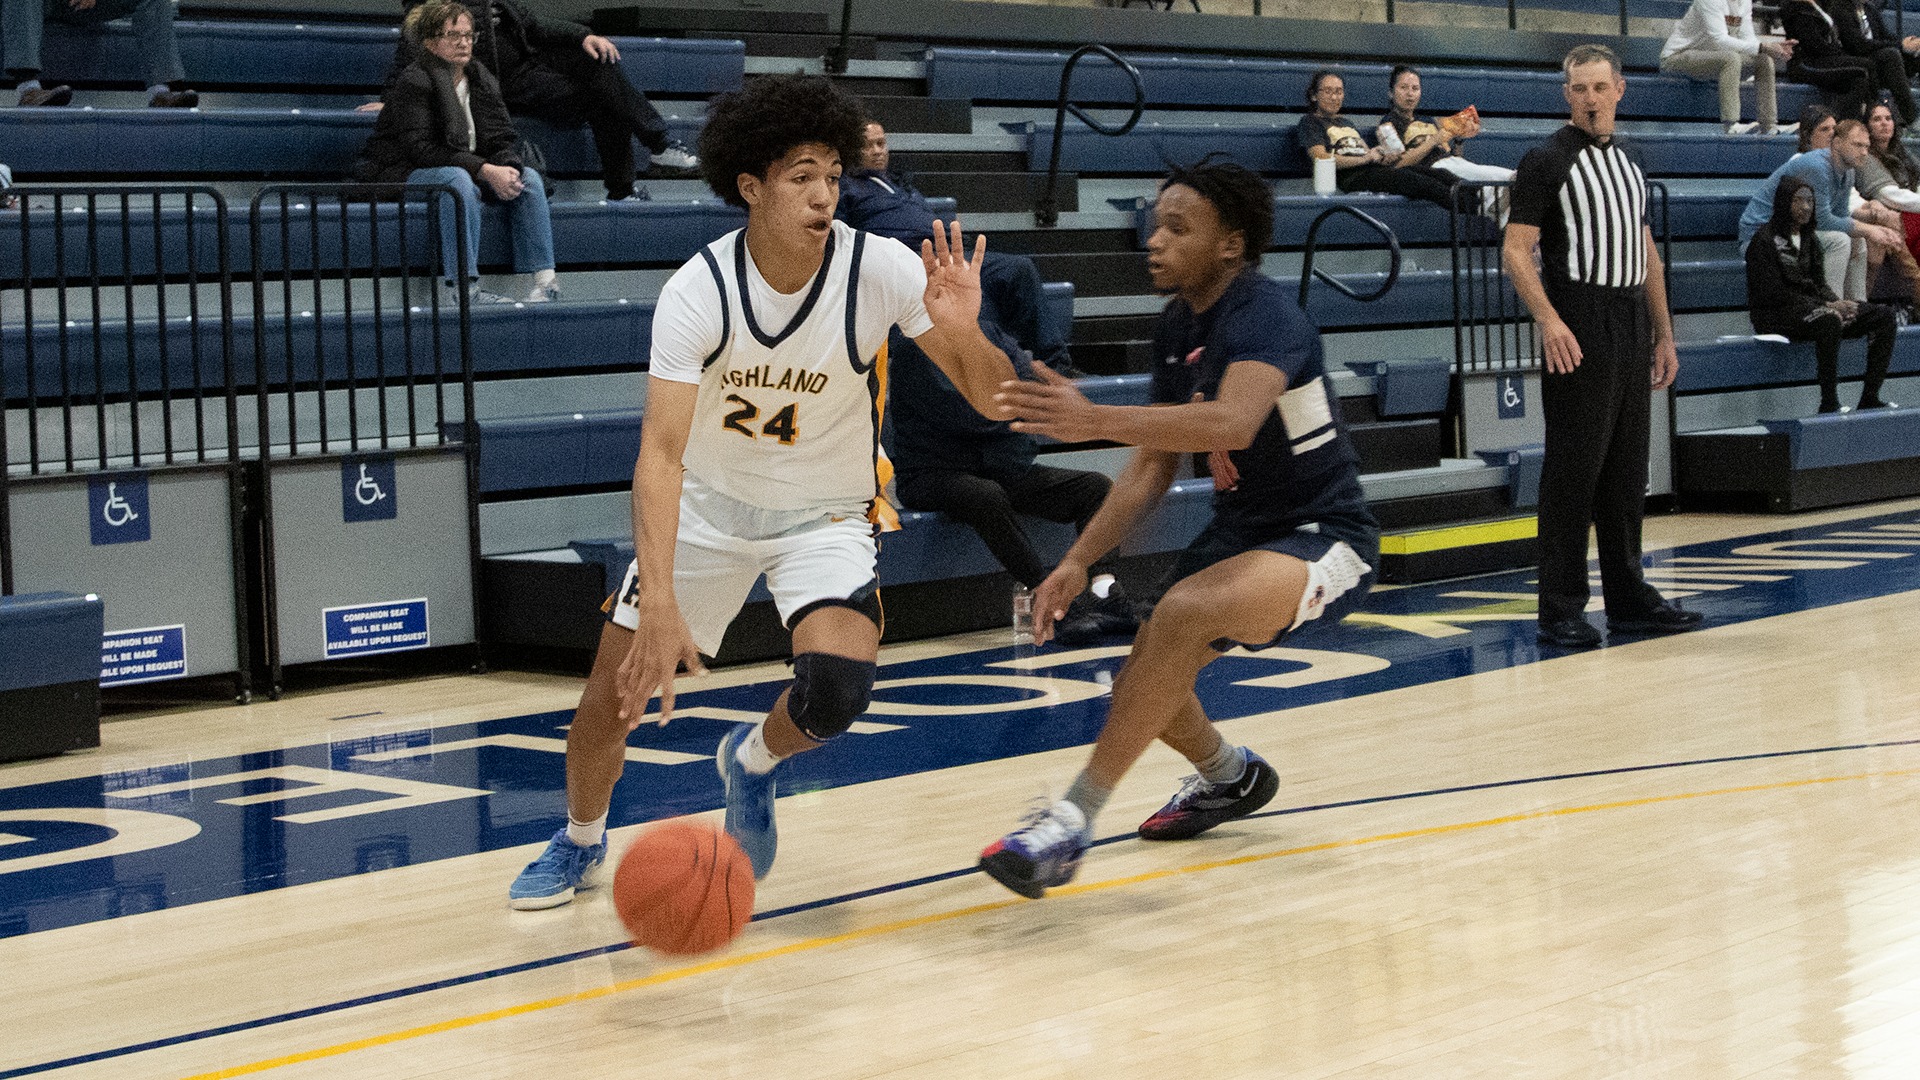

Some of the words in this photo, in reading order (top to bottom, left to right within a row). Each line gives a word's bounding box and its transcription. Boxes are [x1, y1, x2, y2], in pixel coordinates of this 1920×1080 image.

[721, 365, 829, 394] IGHLAND
[722, 394, 800, 446] 24
[344, 611, 389, 622] COMPANION
[391, 608, 410, 617] SEAT
[103, 638, 142, 649] MPANION
[144, 636, 164, 645] SEAT
[329, 639, 369, 650] AVAILABLE
[371, 636, 391, 645] UPON
[393, 633, 427, 643] REQUEST
[134, 650, 158, 660] MADE
[121, 665, 144, 675] UPON
[146, 660, 184, 672] REQUEST
